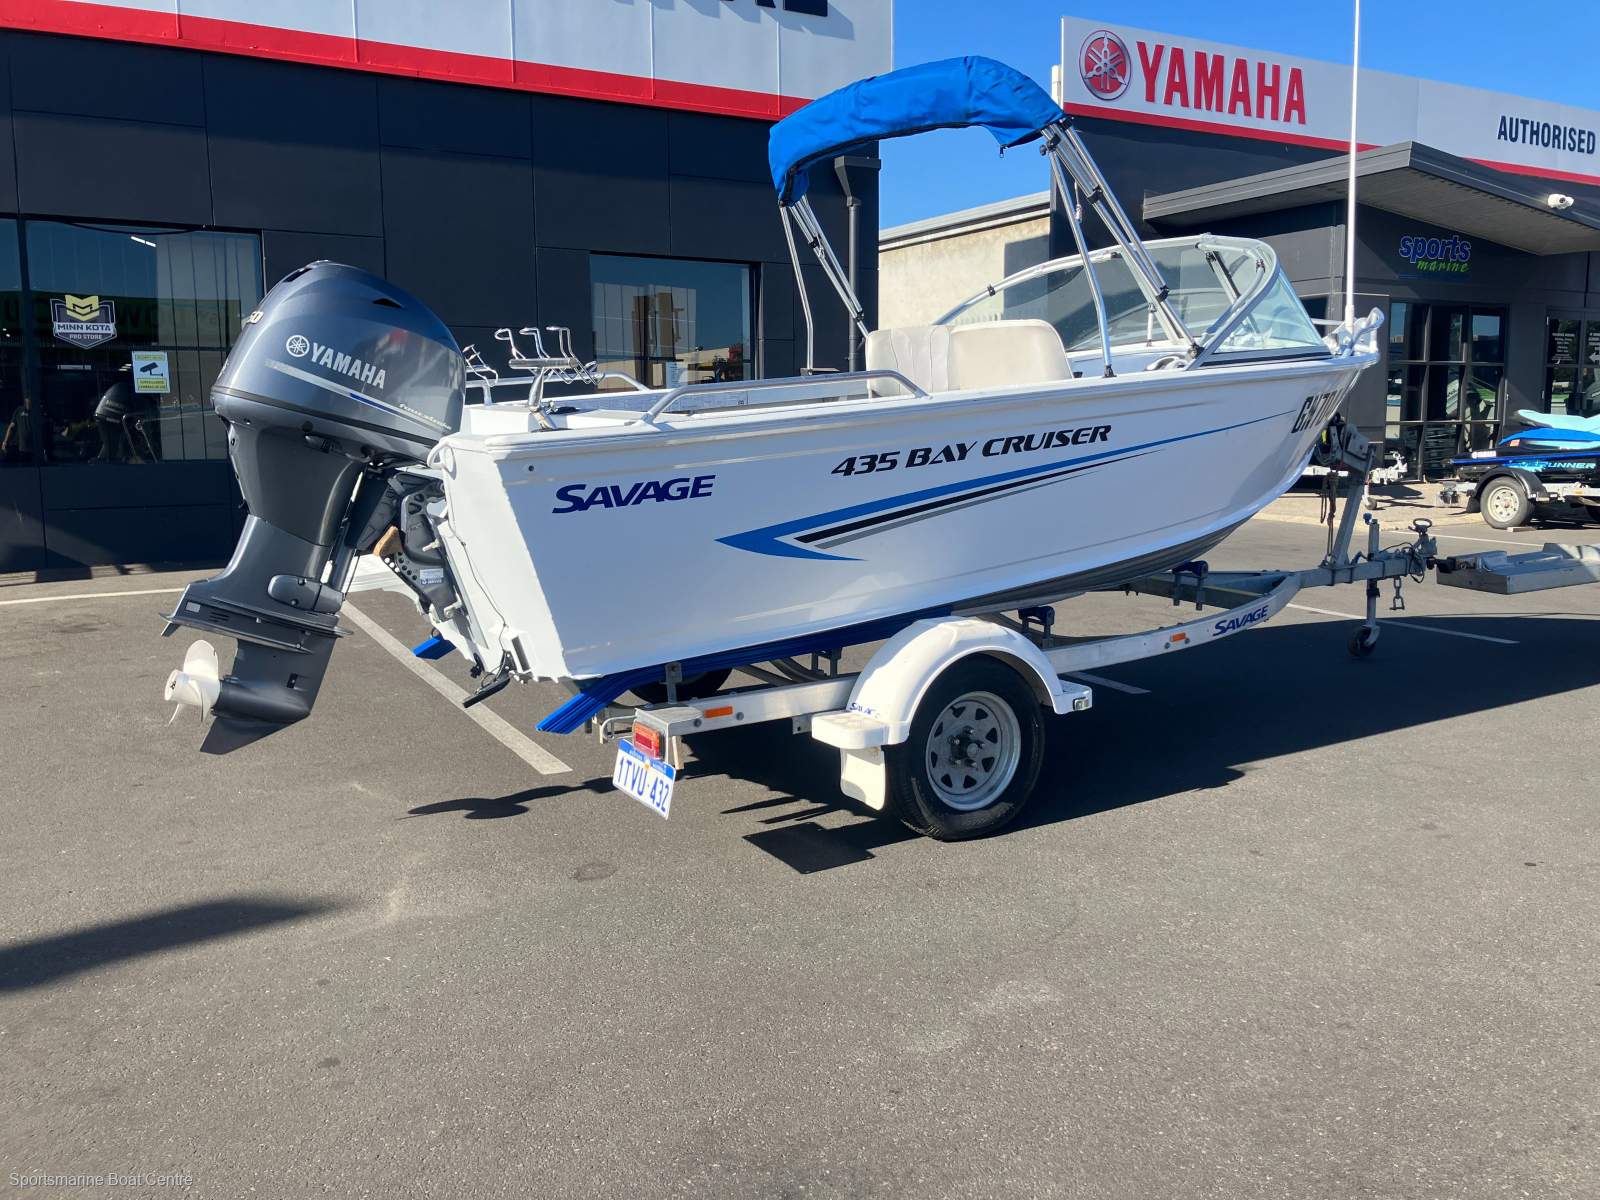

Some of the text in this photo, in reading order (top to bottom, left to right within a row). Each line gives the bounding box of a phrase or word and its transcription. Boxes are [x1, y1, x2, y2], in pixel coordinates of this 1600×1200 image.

[1136, 40, 1306, 125] YAMAHA
[1497, 115, 1596, 155] AUTHORISED
[1399, 234, 1471, 263] sports
[1416, 260, 1470, 272] marine
[57, 323, 84, 331] MINN
[310, 342, 386, 390] YAMAHA
[830, 425, 1112, 477] 435 BAY CRUISER
[552, 474, 716, 514] SAVAGE
[1212, 605, 1269, 637] SAVAGE
